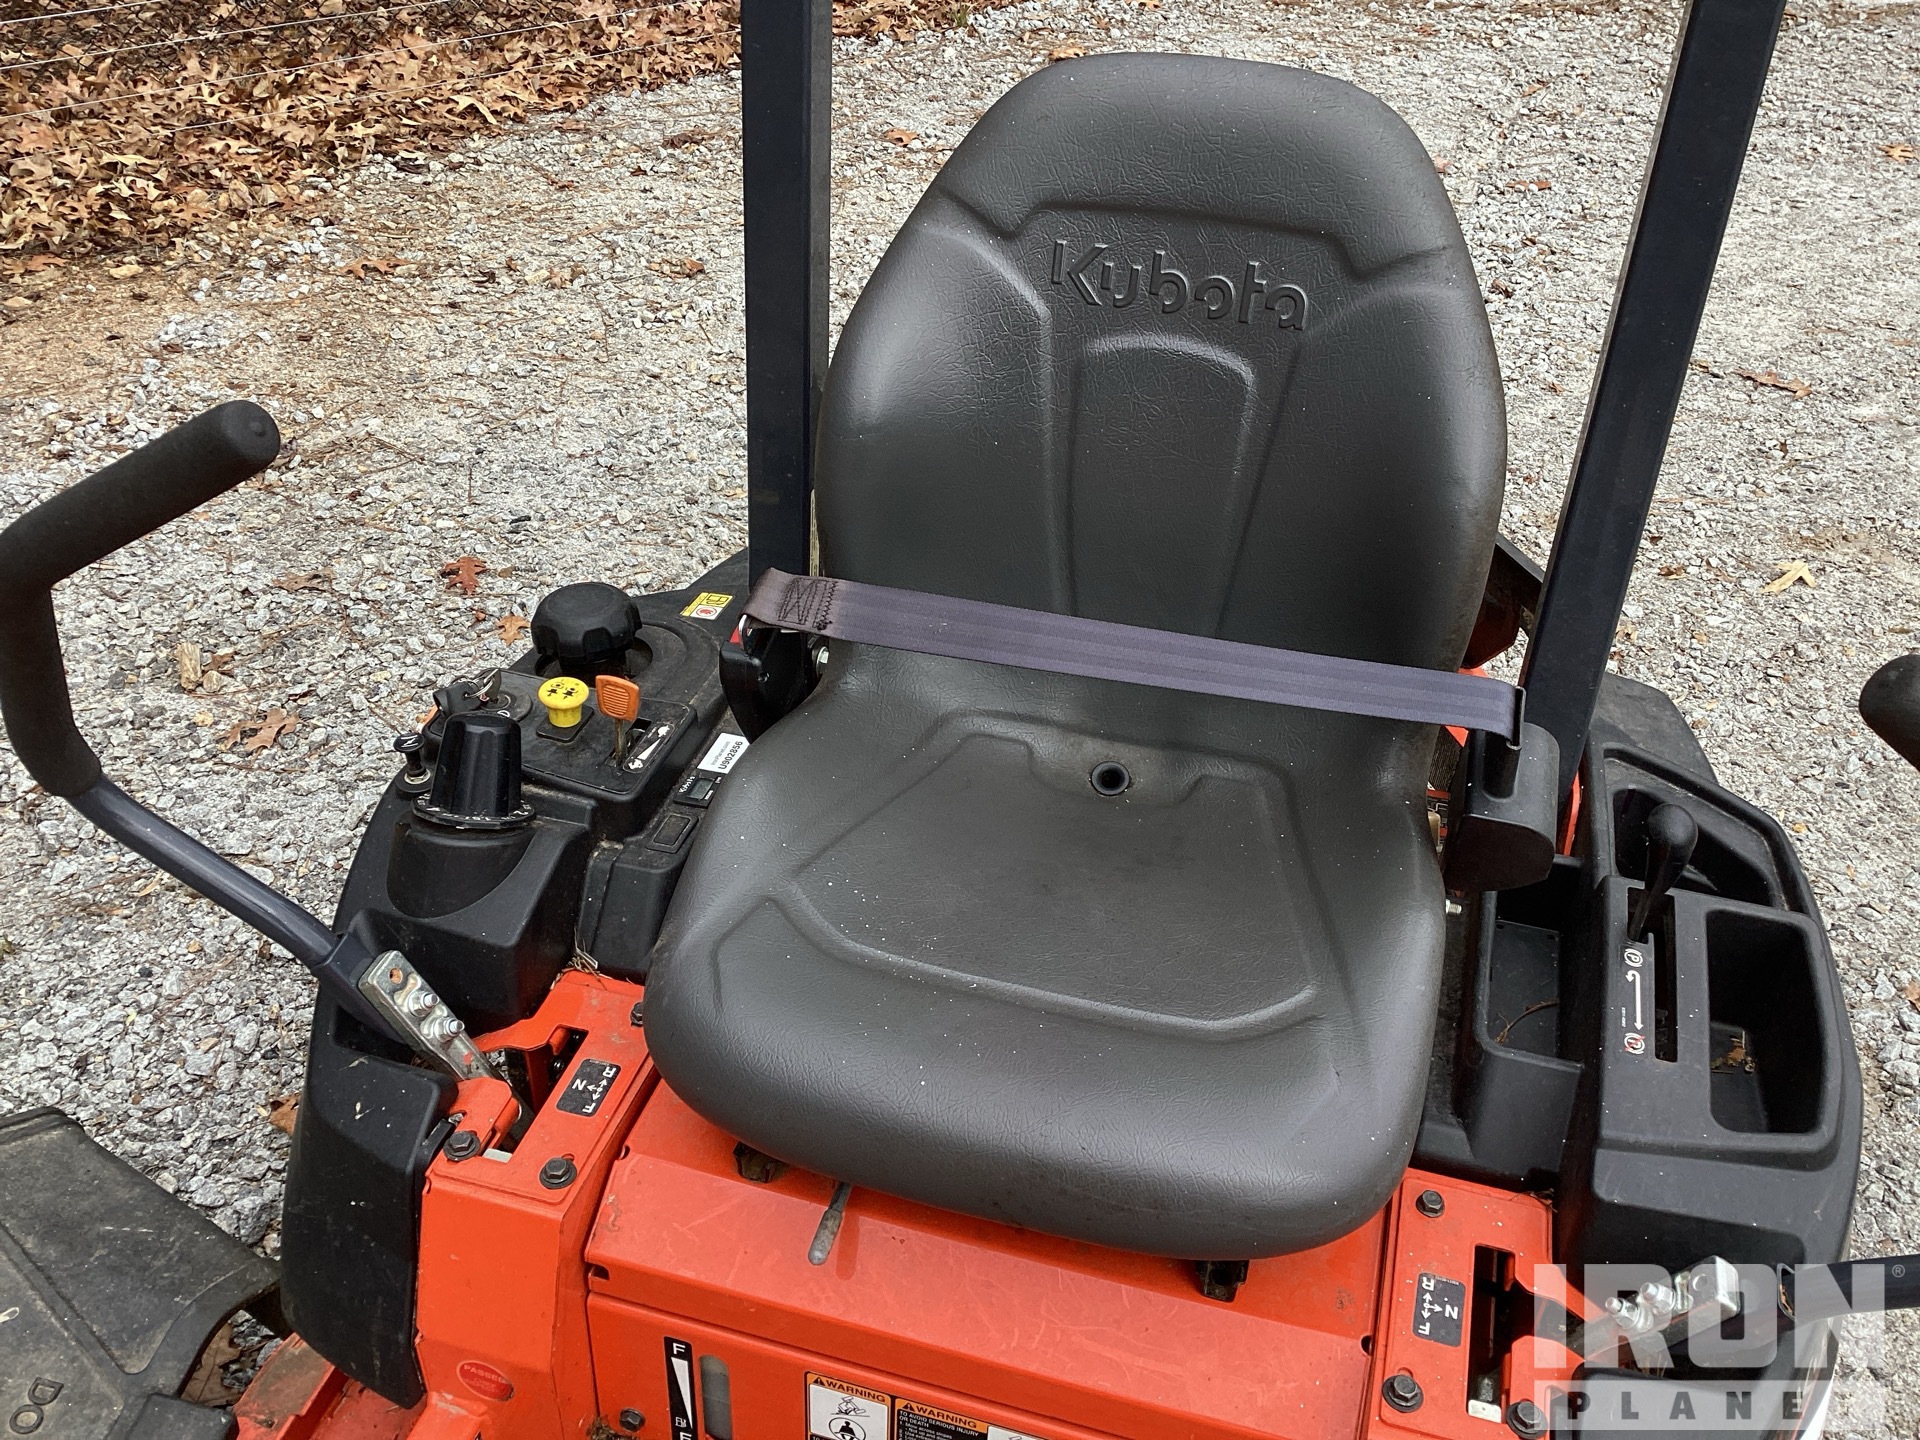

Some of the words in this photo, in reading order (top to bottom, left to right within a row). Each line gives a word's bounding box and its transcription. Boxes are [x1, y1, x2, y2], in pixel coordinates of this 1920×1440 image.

[1051, 239, 1307, 331] Kubota
[718, 741, 743, 769] U902856
[603, 1066, 616, 1078] R
[572, 1079, 587, 1091] N
[582, 1103, 596, 1114] F
[1422, 1276, 1435, 1291] R
[1445, 1304, 1458, 1320] N
[1418, 1322, 1430, 1336] F
[672, 1342, 686, 1355] F
[826, 1380, 886, 1403] WARNING
[909, 1419, 929, 1427] DEATH
[909, 1413, 928, 1422] AVOID
[929, 1418, 956, 1431] SERIOUS
[957, 1426, 979, 1437] INJURY
[916, 1406, 977, 1429] WARNING
